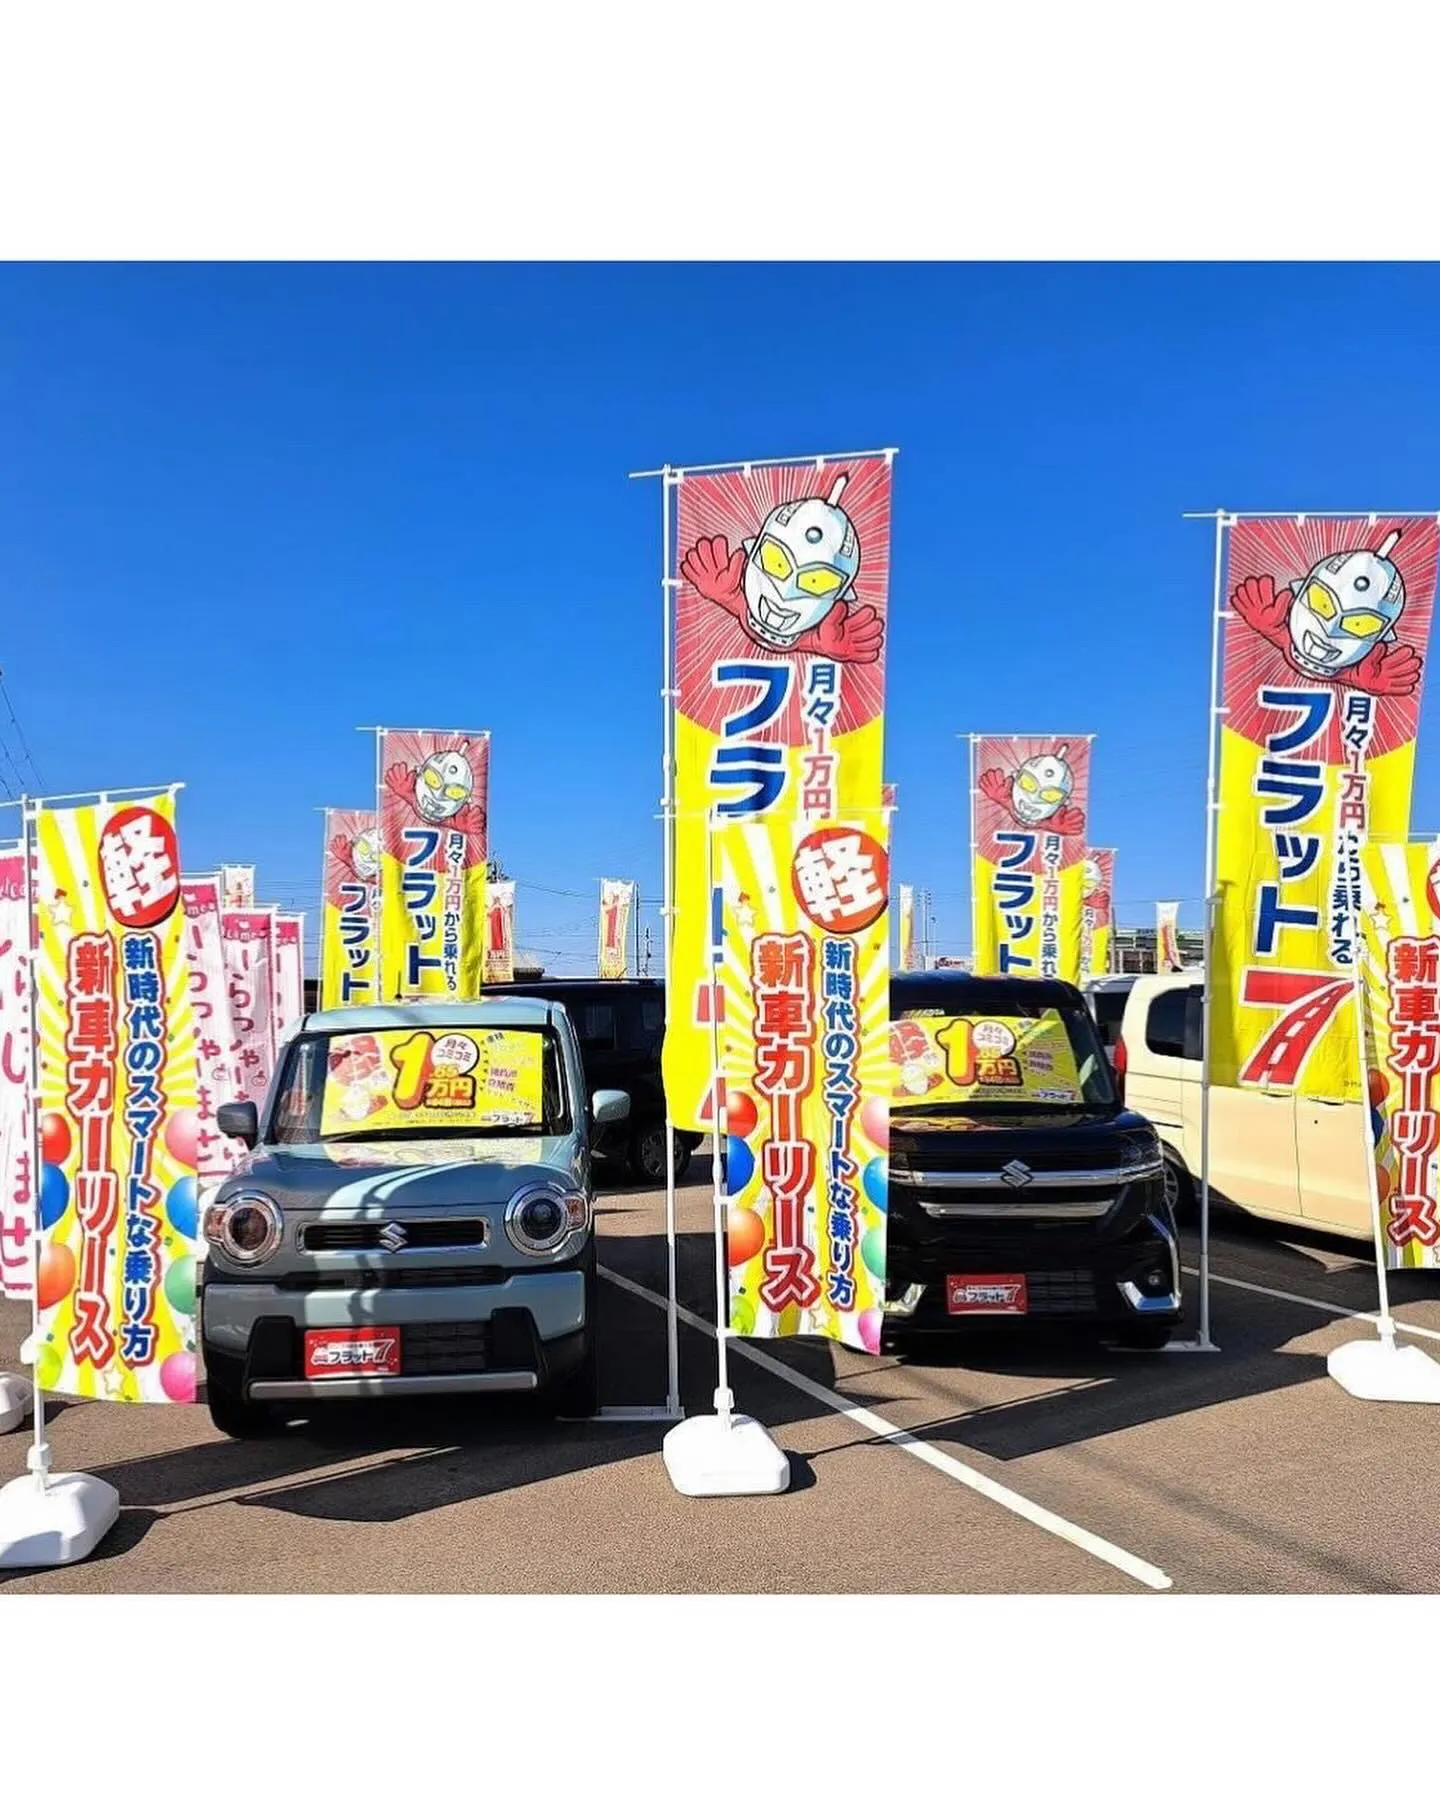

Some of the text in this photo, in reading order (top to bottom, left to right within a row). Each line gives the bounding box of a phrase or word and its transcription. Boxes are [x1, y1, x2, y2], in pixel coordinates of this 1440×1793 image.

[102, 813, 176, 917] 軽
[340, 885, 370, 1001] フラット
[402, 830, 442, 985] フラット
[443, 833, 465, 991] 月々1万円から乗れる
[795, 835, 883, 923] 軽
[994, 833, 1036, 973] フラット
[66, 937, 116, 1362] 新車カーリース
[122, 935, 164, 1360] 新時代のスマートな乗り方
[754, 935, 818, 1312] 新車カーリース
[824, 937, 857, 1306] 新時代のスマートな乗り方
[1389, 940, 1440, 1244] 新車カーリース
